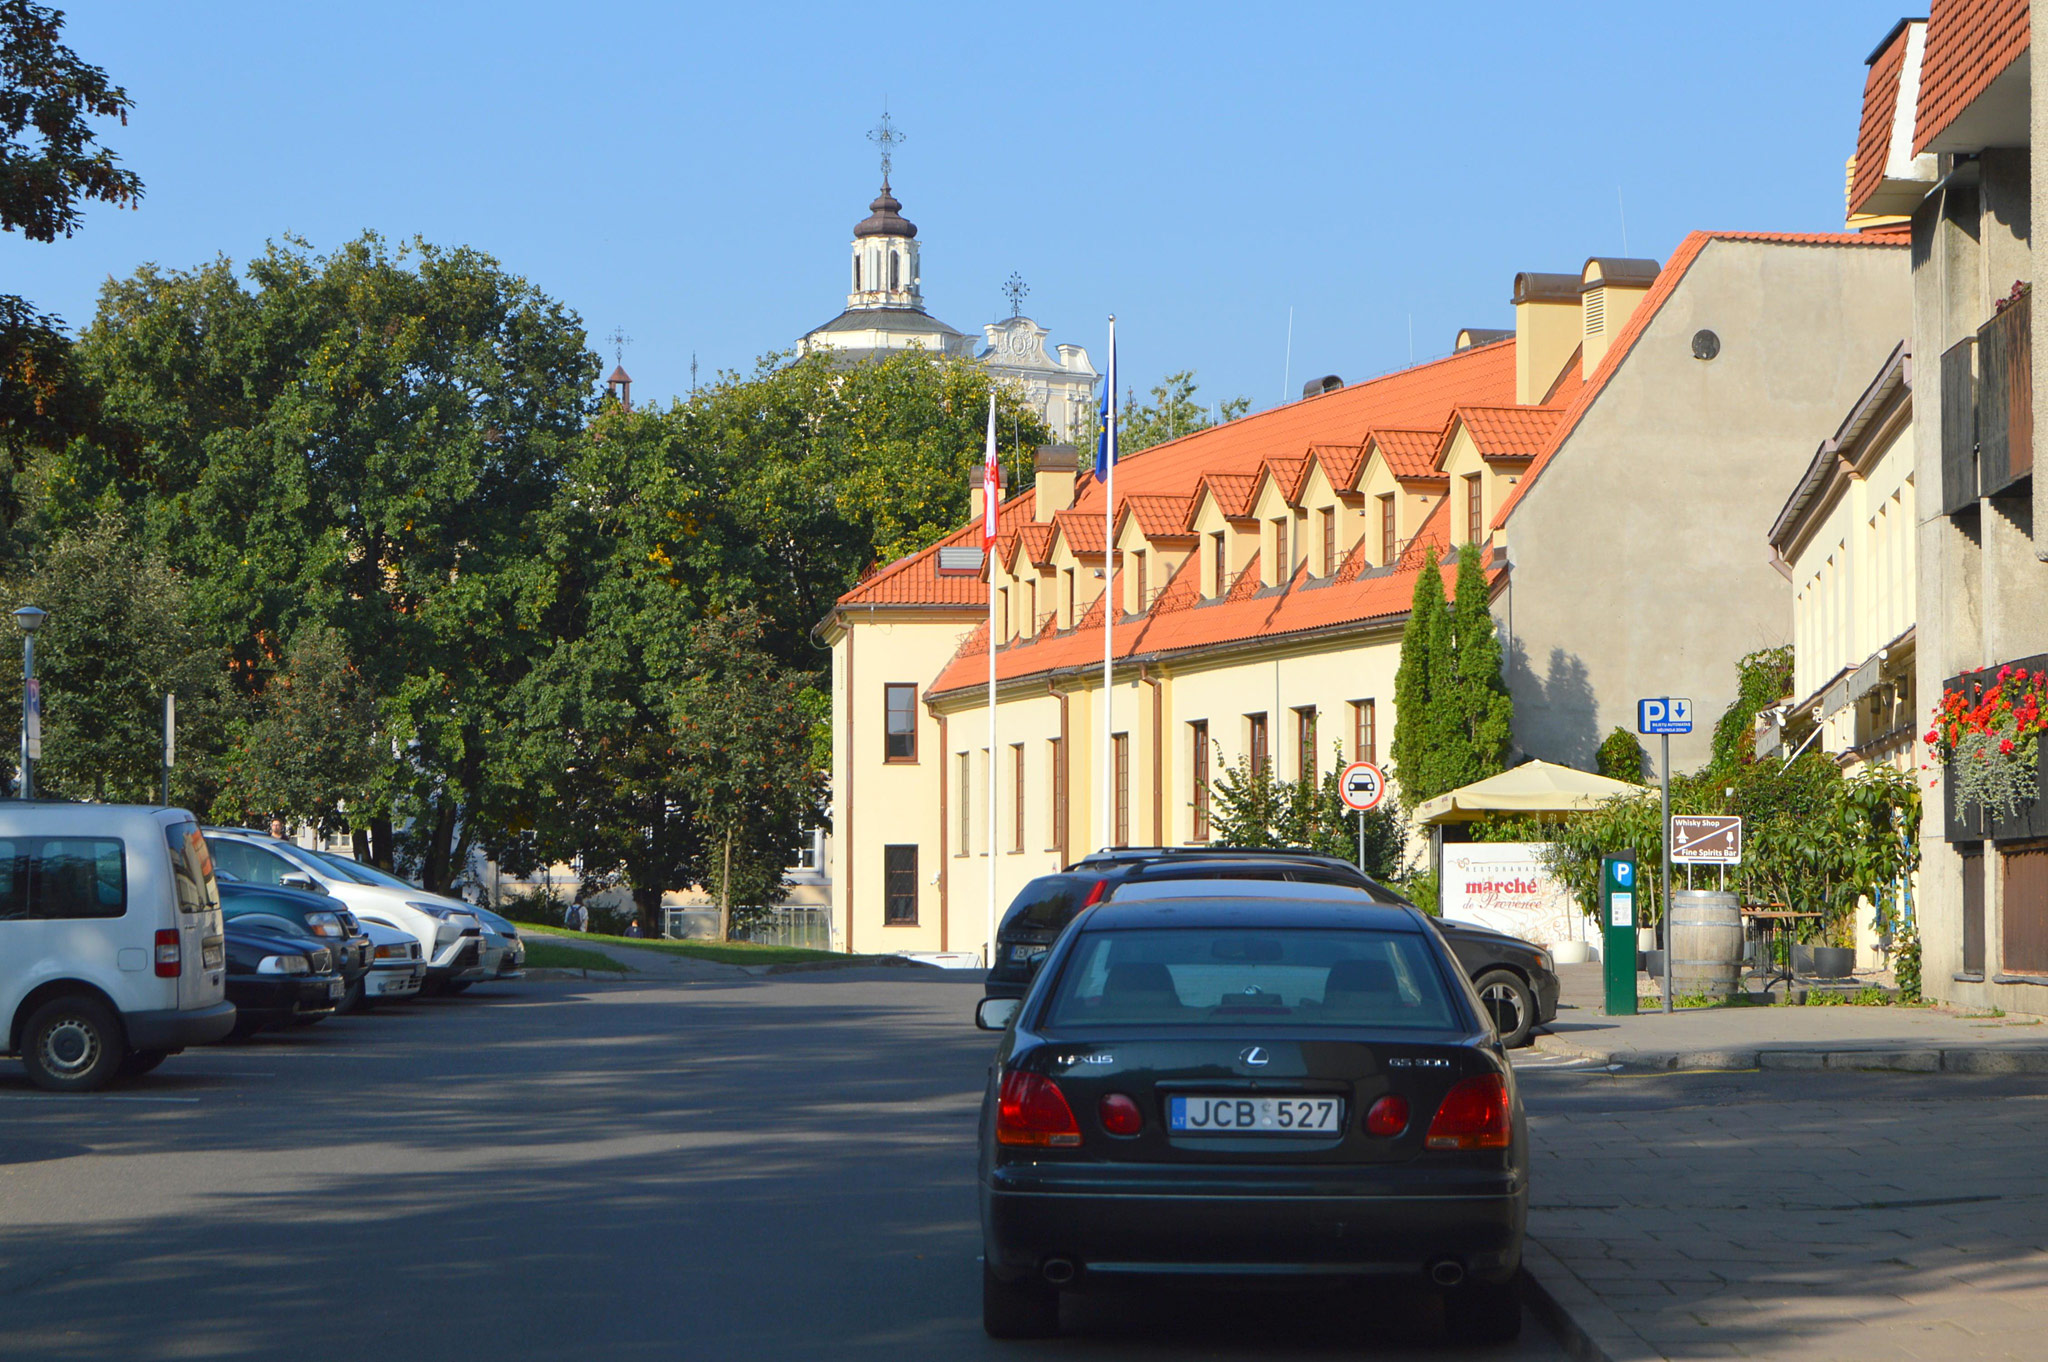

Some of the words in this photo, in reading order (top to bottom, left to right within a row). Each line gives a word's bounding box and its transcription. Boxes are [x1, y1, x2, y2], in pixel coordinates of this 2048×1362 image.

[1644, 701, 1665, 732] P
[1675, 819, 1701, 828] Whisky
[1702, 820, 1720, 828] Shop
[1699, 849, 1722, 857] Spirits
[1617, 863, 1630, 882] P
[1465, 877, 1537, 894] marché
[1462, 897, 1474, 909] de
[1479, 892, 1542, 909] Provence
[1190, 1100, 1255, 1128] JCB
[1277, 1101, 1334, 1129] 527
